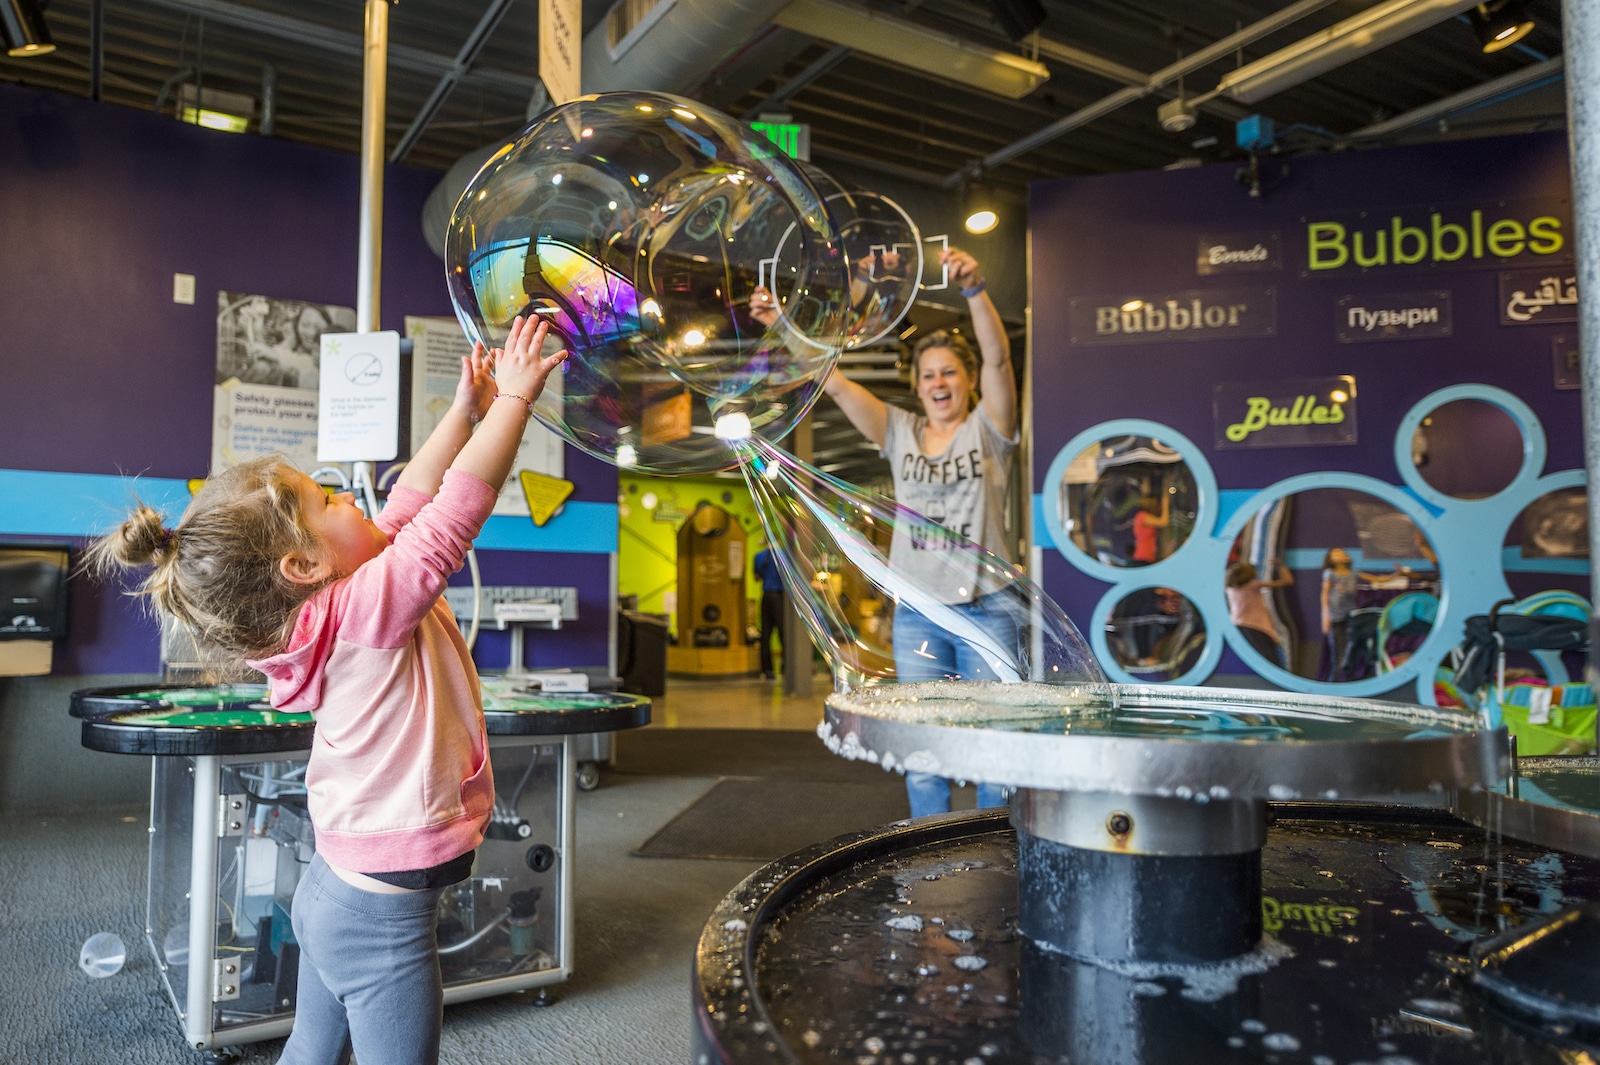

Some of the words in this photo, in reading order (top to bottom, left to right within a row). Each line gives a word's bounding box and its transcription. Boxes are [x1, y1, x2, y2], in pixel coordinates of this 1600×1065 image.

[1307, 209, 1565, 271] Bubbles
[1095, 298, 1247, 336] Bubblor
[1347, 305, 1438, 332] Пузыри
[234, 405, 276, 417] protect
[279, 409, 303, 421] your
[235, 391, 271, 407] Safety
[273, 396, 316, 409] glasses
[1226, 395, 1346, 442] Bulles
[901, 448, 983, 484] COFFEE
[909, 523, 972, 551] WINE
